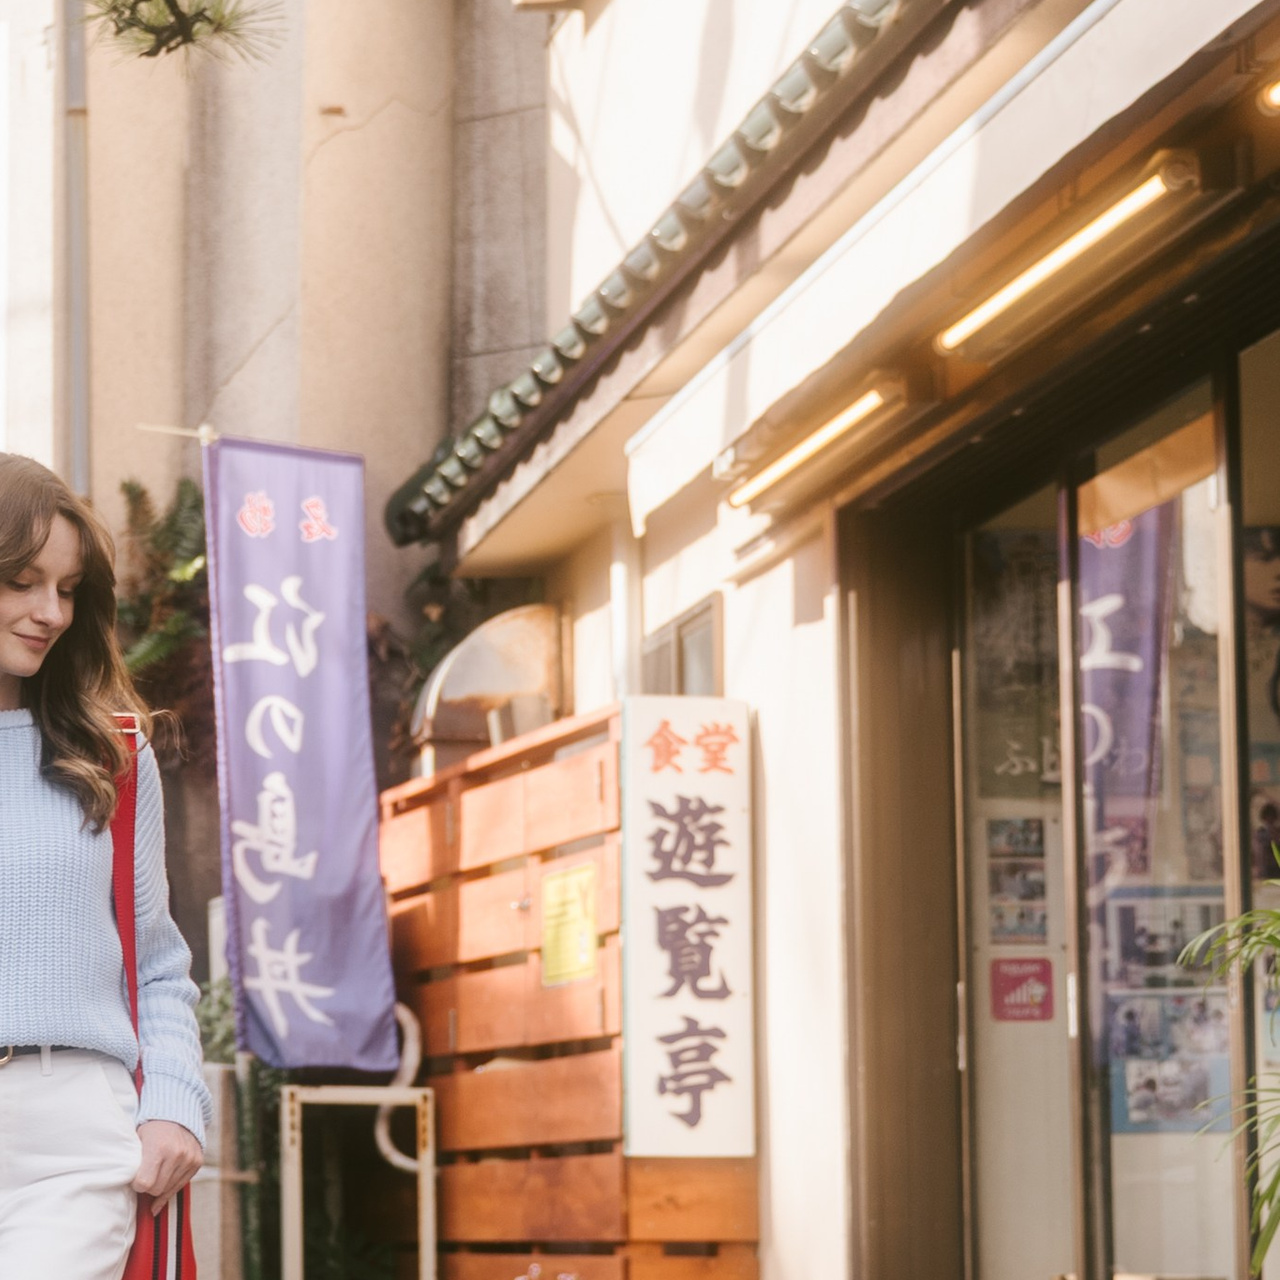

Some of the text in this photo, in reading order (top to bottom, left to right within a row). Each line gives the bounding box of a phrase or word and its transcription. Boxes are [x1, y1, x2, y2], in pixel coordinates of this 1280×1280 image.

[643, 718, 741, 776] 食堂
[645, 794, 736, 1129] 遊覧亭
